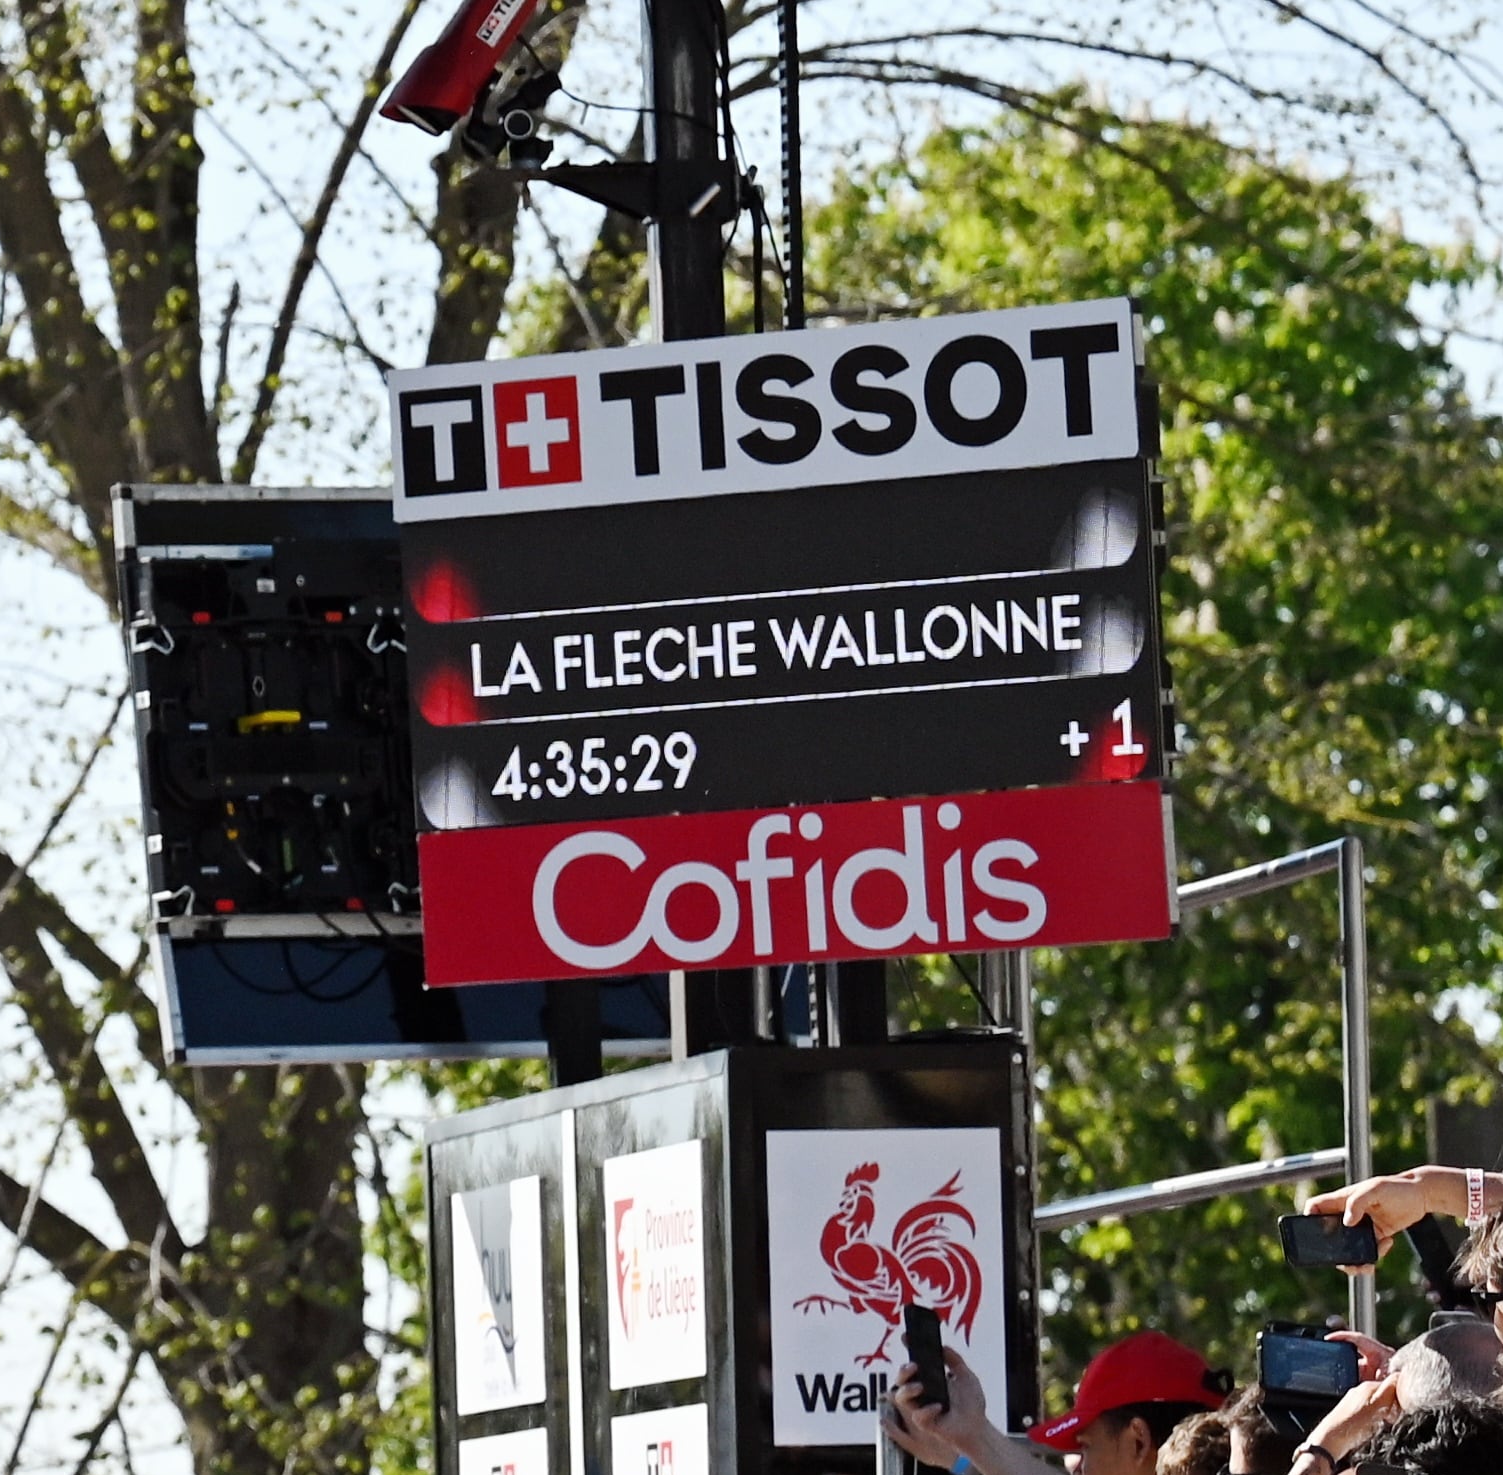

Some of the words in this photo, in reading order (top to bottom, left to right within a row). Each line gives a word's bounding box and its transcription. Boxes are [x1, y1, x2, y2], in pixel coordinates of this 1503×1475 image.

[599, 322, 1119, 478] TISSOT
[469, 640, 541, 697] LA
[552, 617, 757, 690] FLECHE
[768, 594, 1083, 670] WALLONNE
[491, 731, 697, 801] 4:35:29
[532, 801, 1048, 971] Cofidis
[645, 1200, 695, 1252] Province
[795, 1371, 898, 1414] Wall
